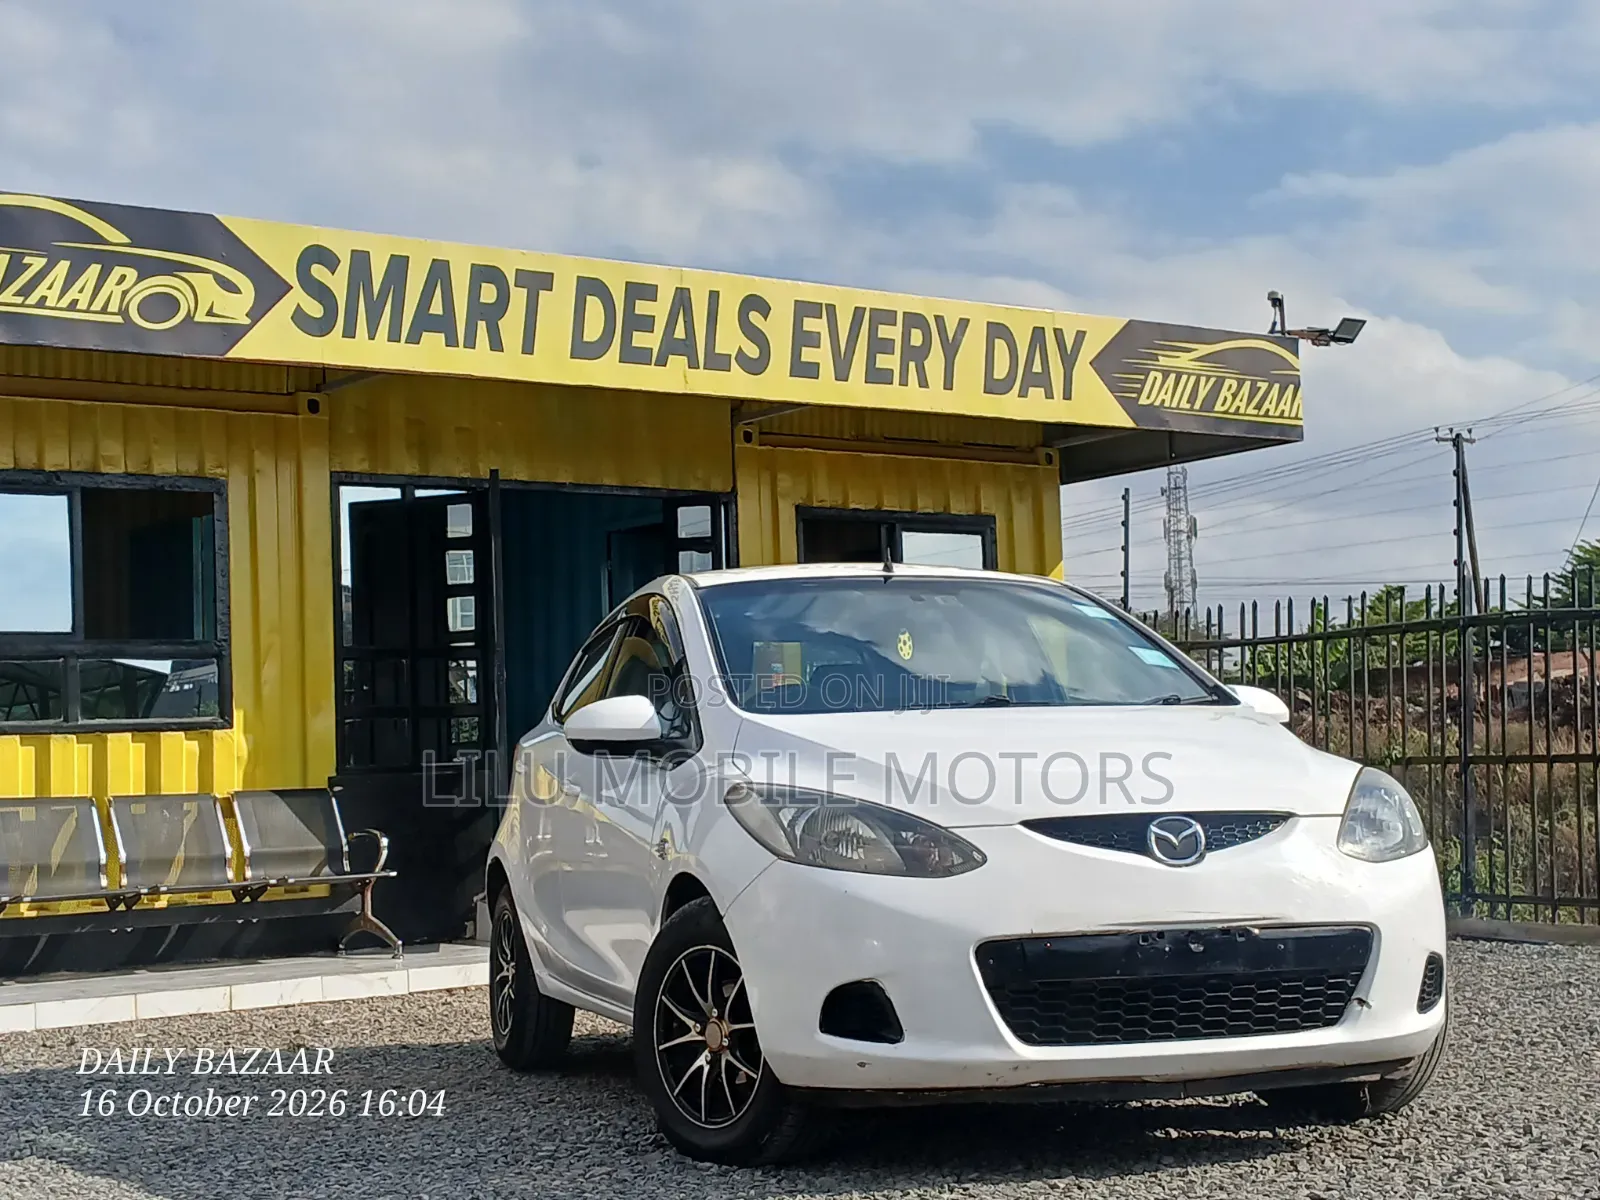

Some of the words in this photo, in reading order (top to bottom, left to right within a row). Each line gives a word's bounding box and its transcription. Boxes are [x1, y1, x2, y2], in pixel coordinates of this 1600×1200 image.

[290, 243, 555, 356] SMART
[569, 275, 772, 376] DEALS
[789, 299, 970, 391] EVERY
[983, 321, 1087, 401] DAY
[1138, 370, 1217, 410] DAILY
